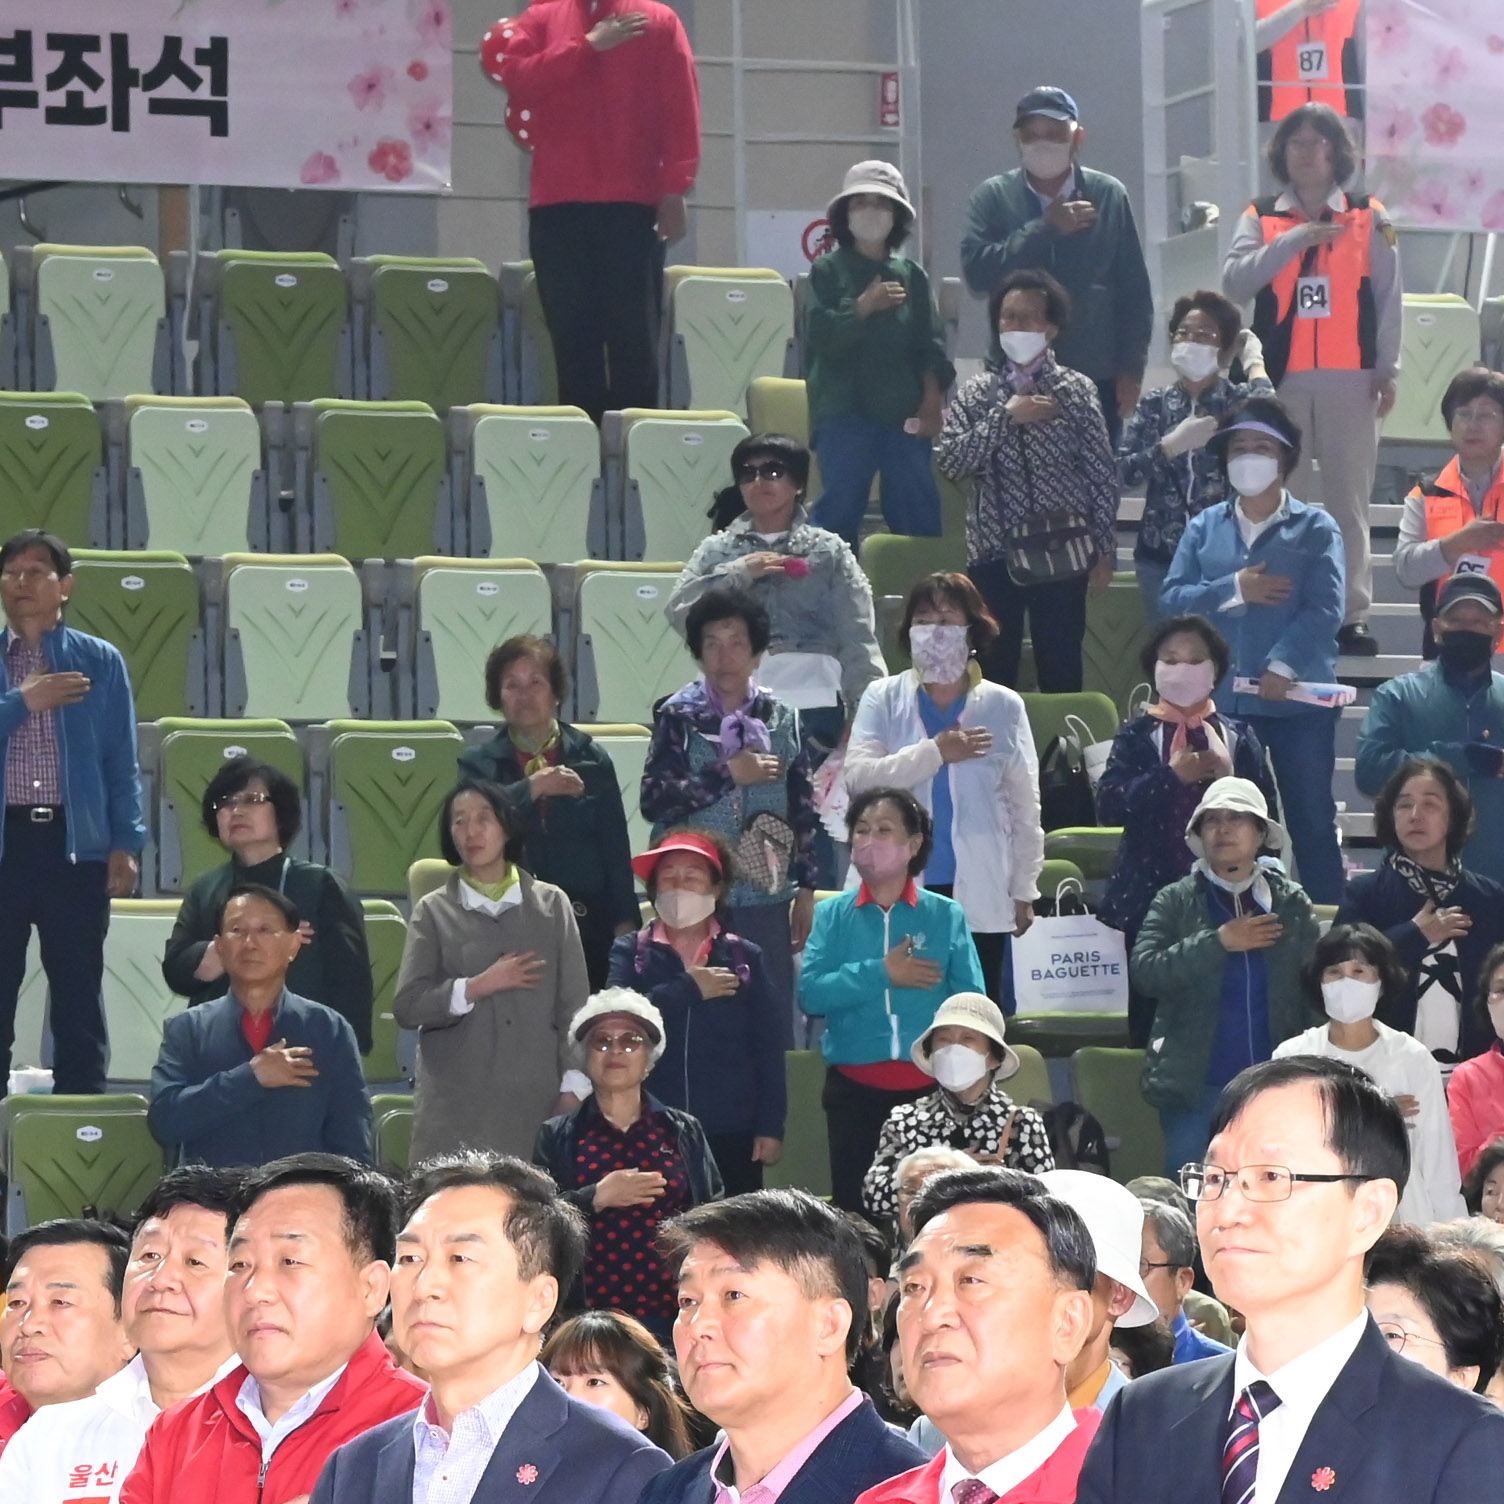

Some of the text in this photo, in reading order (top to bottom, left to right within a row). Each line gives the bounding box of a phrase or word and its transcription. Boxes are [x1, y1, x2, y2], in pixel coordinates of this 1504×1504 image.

[1300, 284, 1327, 309] 64
[1051, 951, 1100, 965] PARIS
[1031, 963, 1121, 981] BAGUETTE
[69, 1460, 118, 1488] 울산
